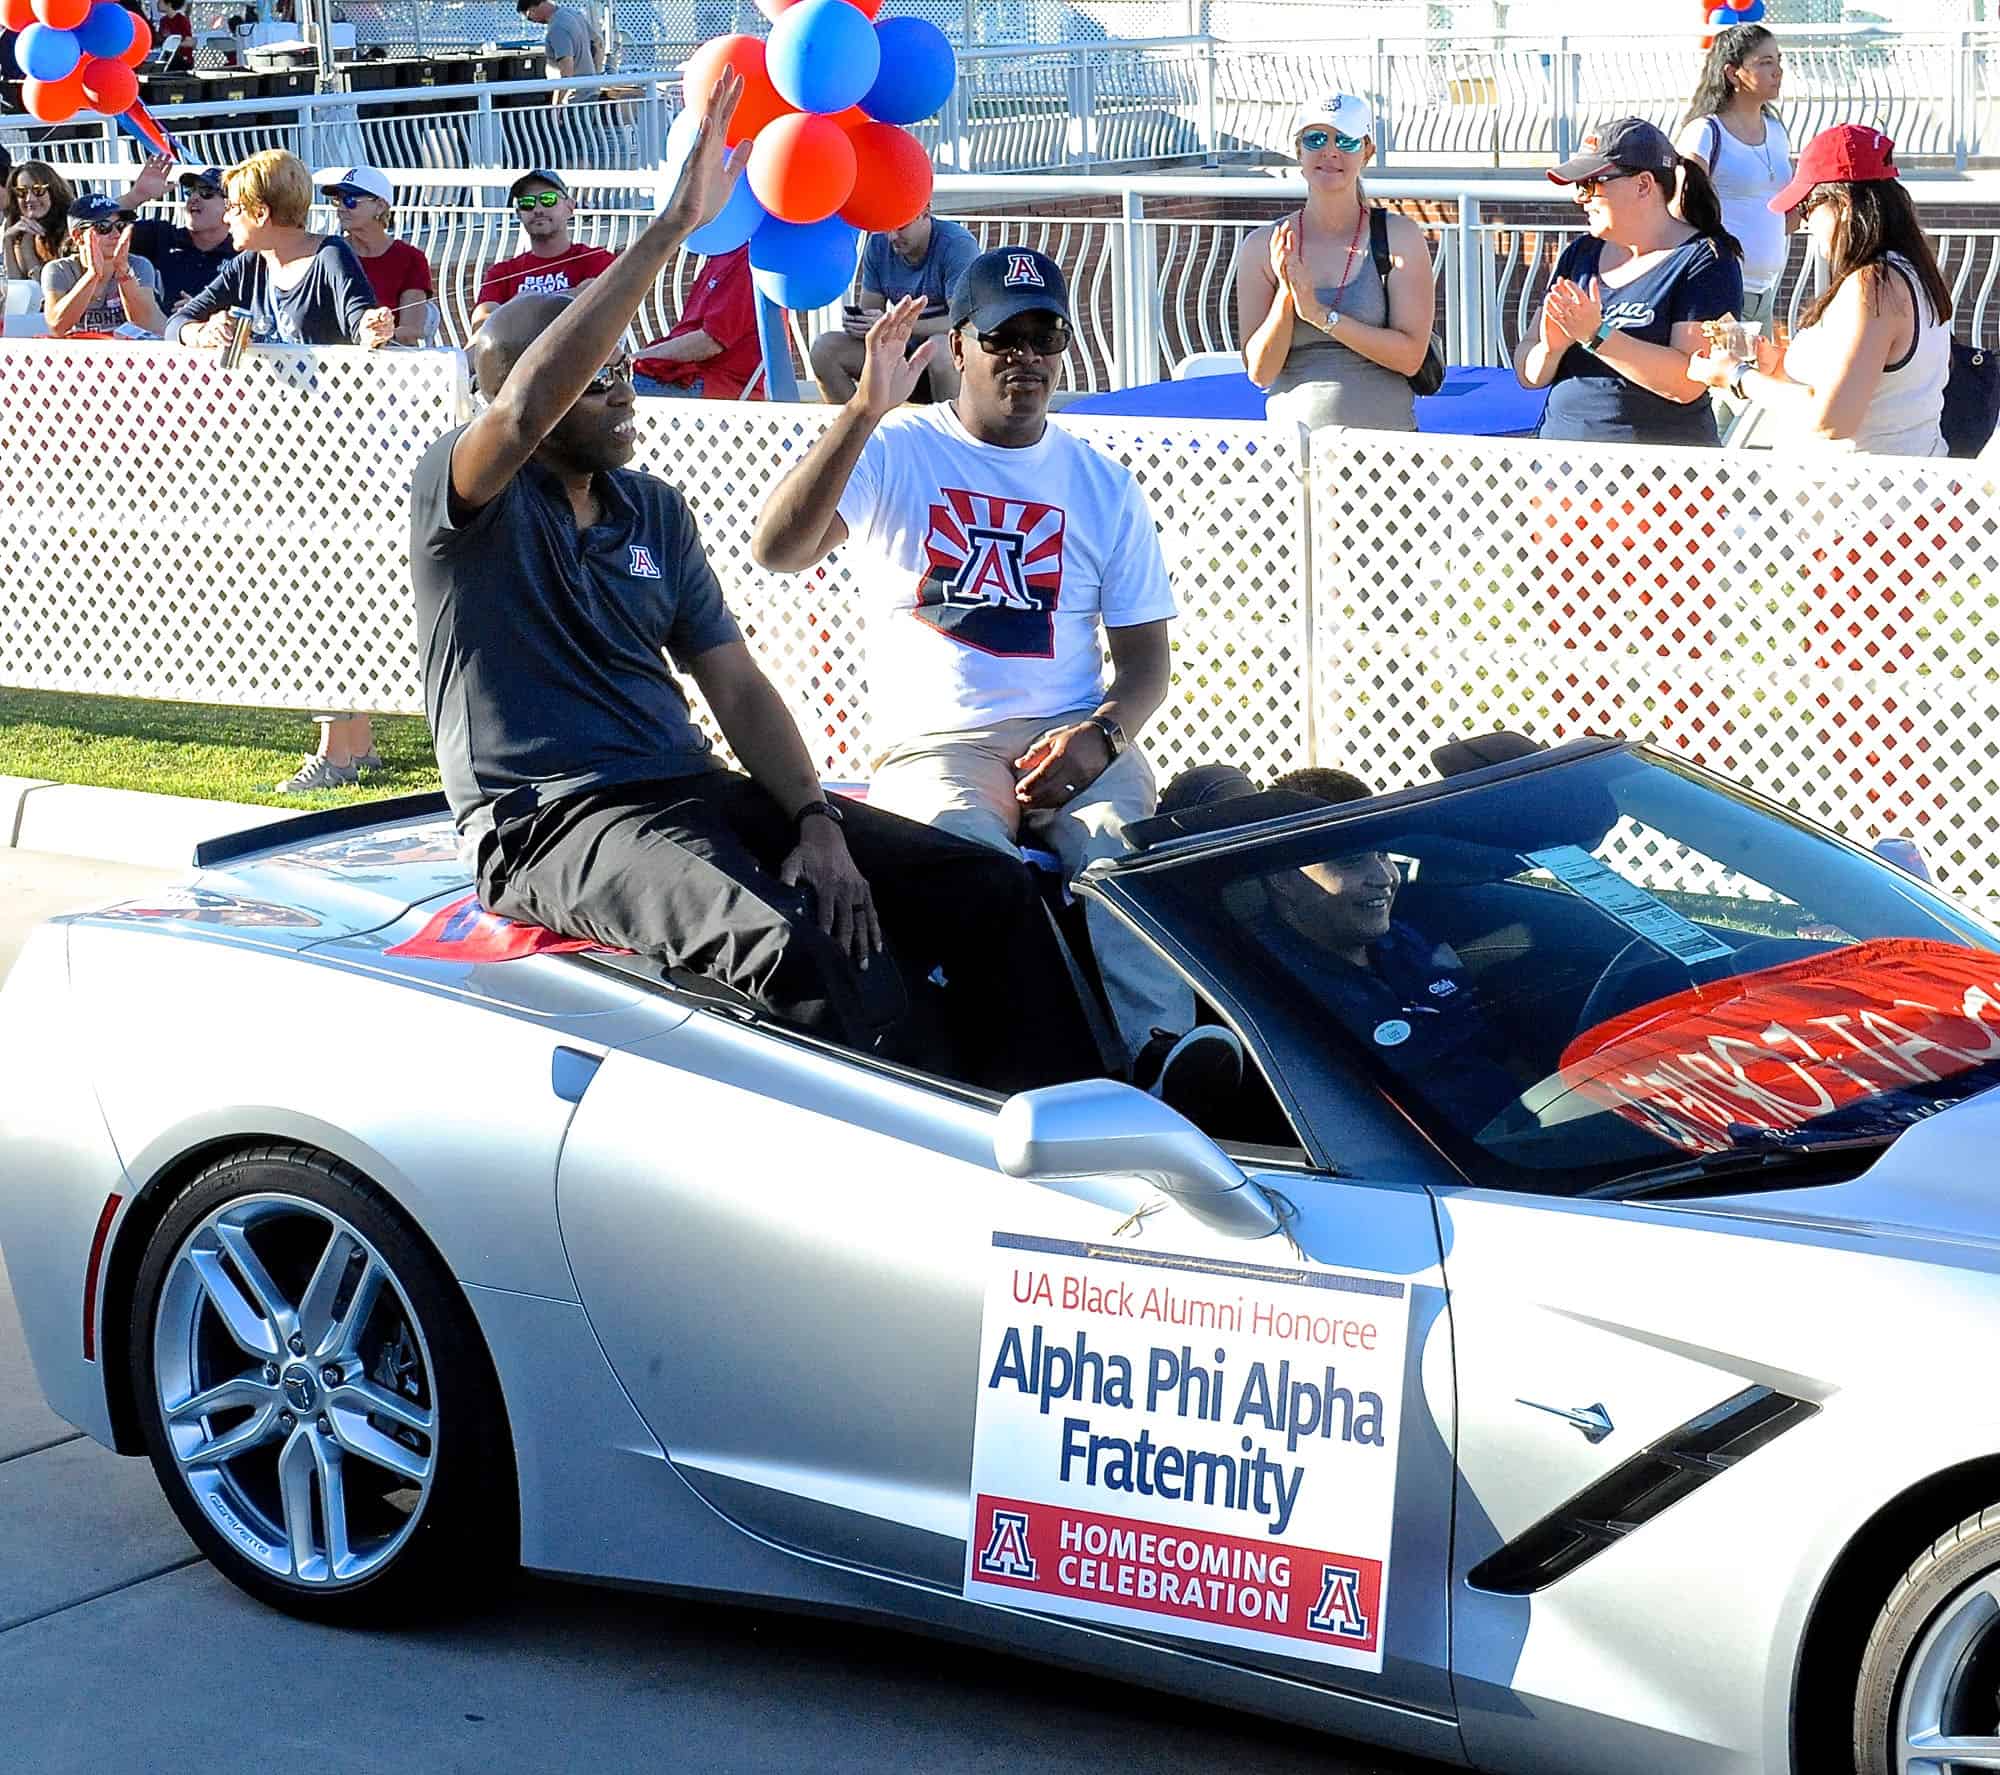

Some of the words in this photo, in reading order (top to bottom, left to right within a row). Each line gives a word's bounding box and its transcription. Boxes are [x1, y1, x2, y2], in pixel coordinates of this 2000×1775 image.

[1004, 254, 1045, 287] A
[629, 545, 661, 579] A
[942, 524, 1042, 610] A
[1012, 1269, 1054, 1307] UA
[1062, 1275, 1134, 1318] Black
[1140, 1287, 1244, 1332] Alumni
[1252, 1301, 1377, 1351] Honoree
[988, 1325, 1134, 1414] Alpha
[1146, 1345, 1226, 1422] Phi
[1233, 1360, 1385, 1453] Alpha
[1060, 1417, 1305, 1535] Fraternity
[978, 1509, 1037, 1582] A
[1059, 1519, 1291, 1588] HOMECOMING
[1057, 1555, 1290, 1623] CELEBRATION
[1306, 1564, 1369, 1641] A
